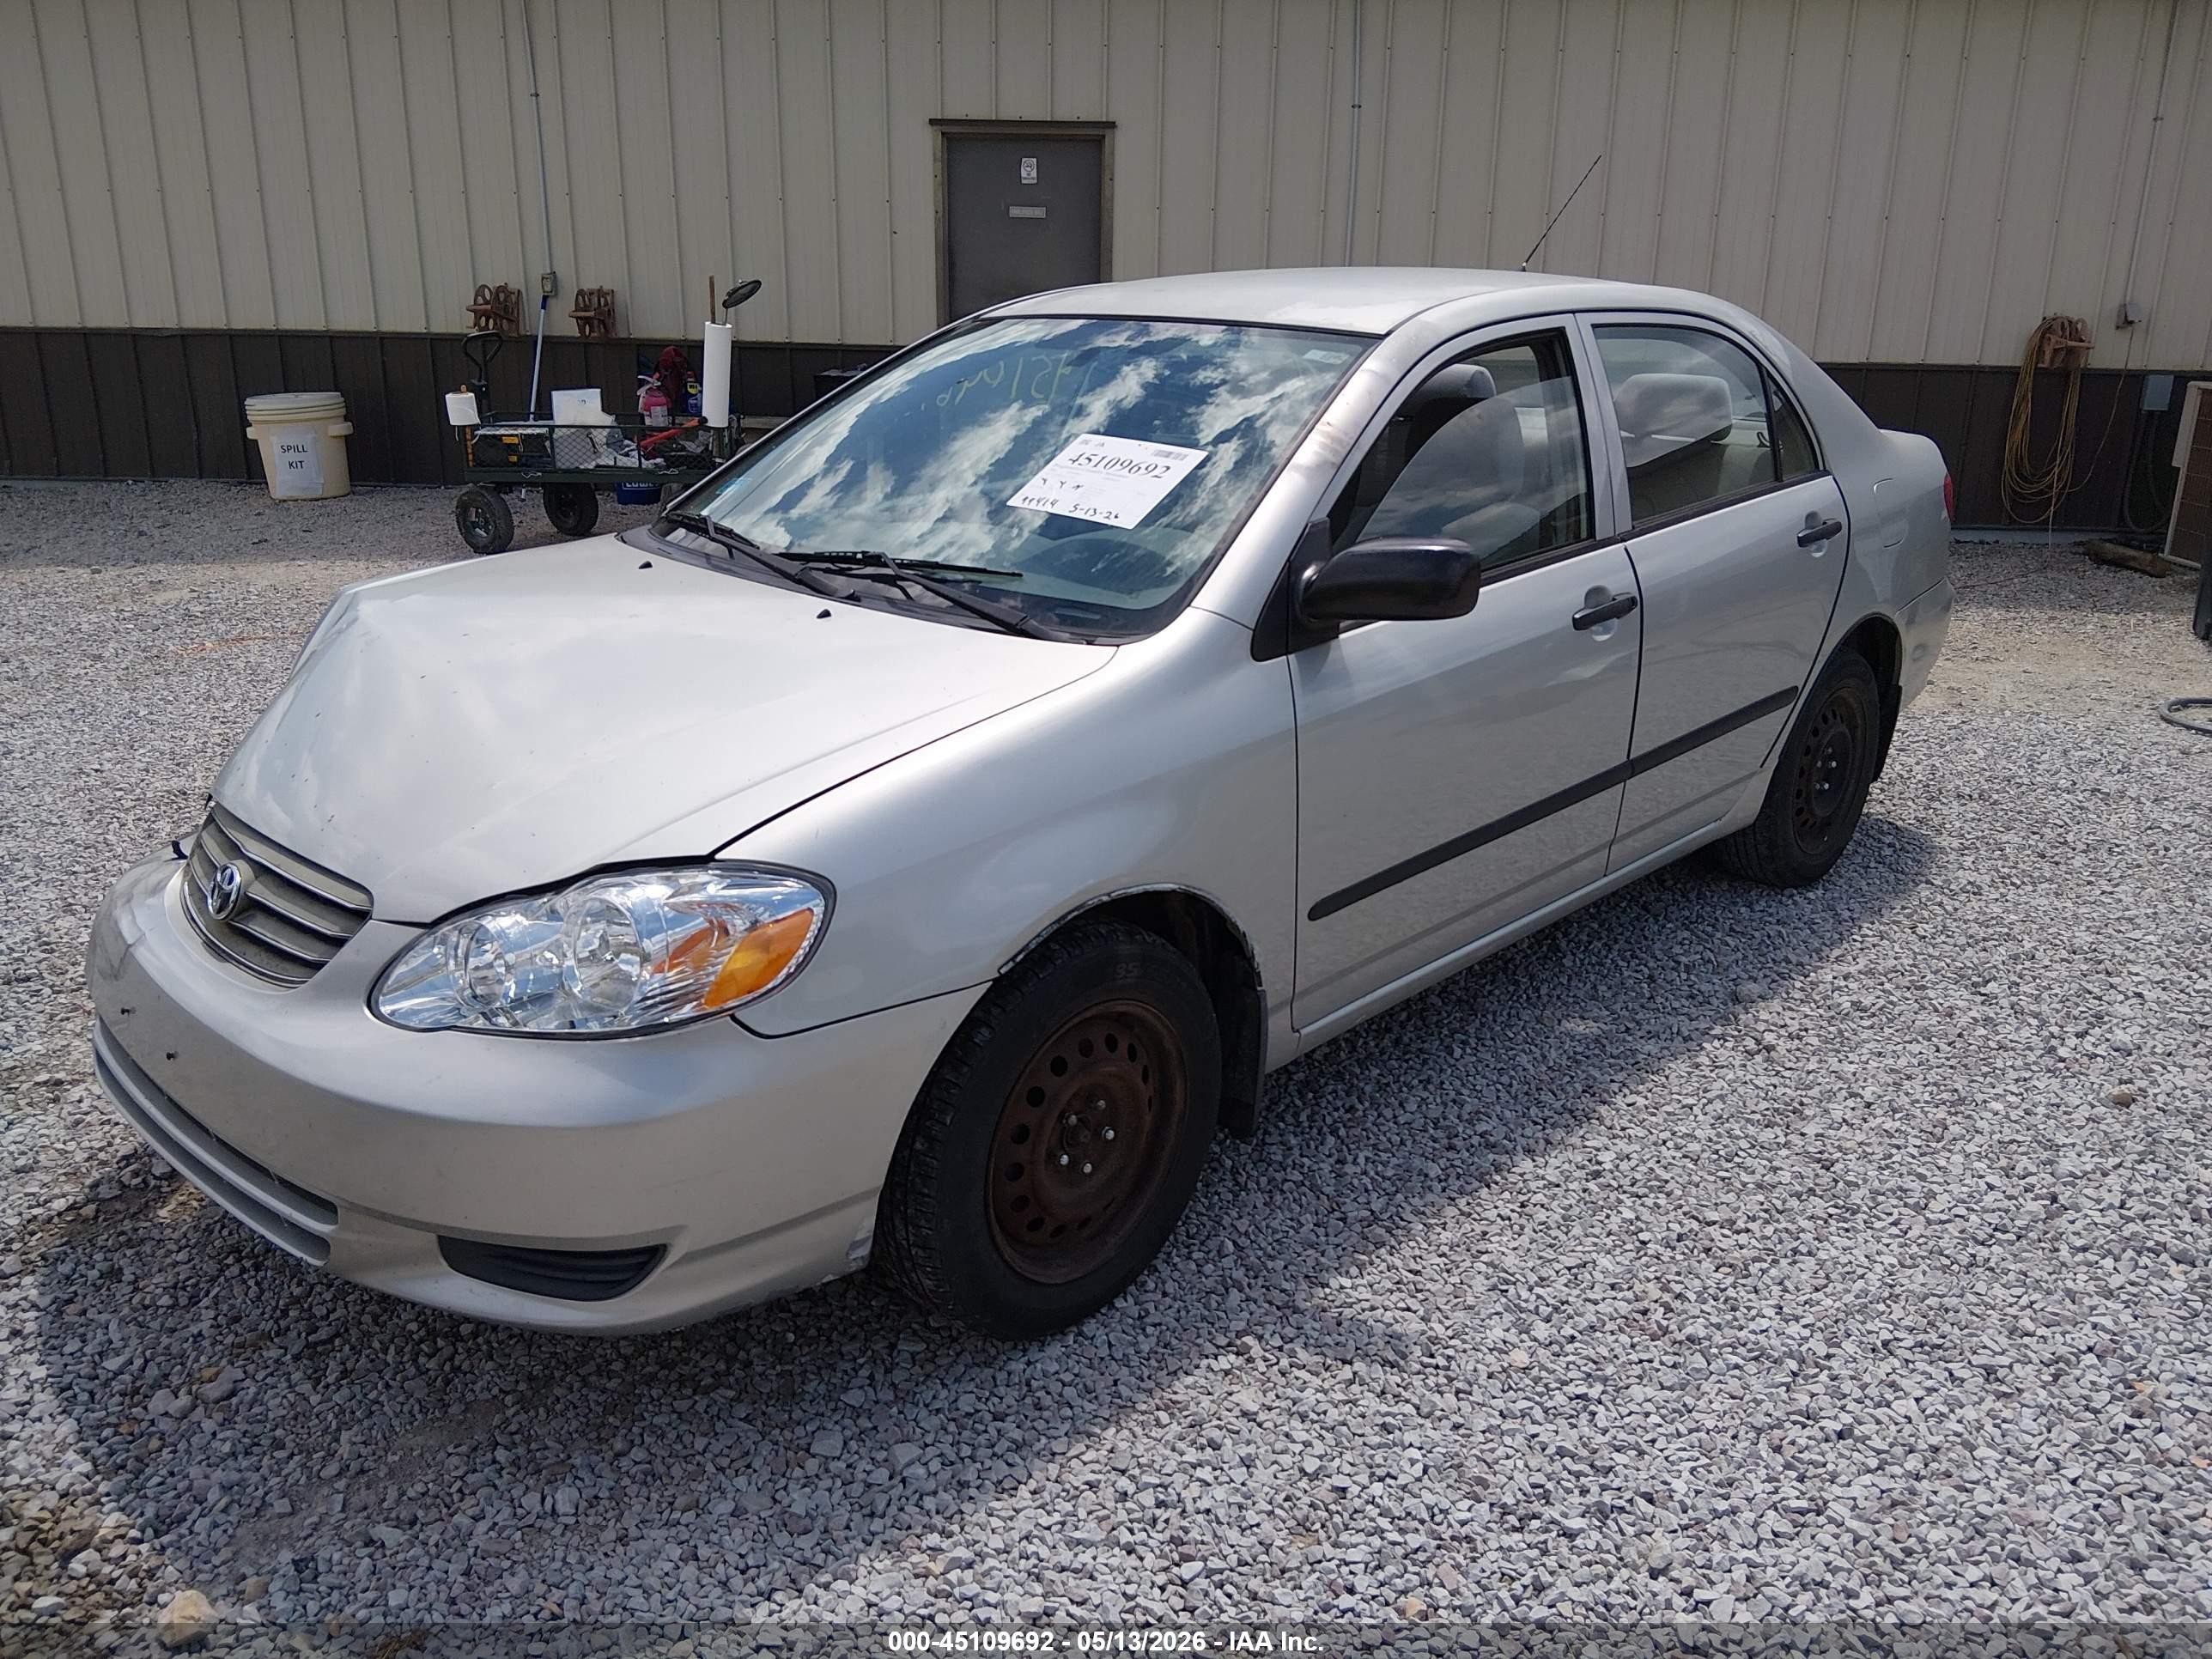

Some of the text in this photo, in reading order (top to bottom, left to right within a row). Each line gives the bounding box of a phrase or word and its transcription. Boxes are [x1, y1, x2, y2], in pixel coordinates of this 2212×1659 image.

[280, 445, 308, 453] SPILL
[288, 460, 305, 469] KIT
[1068, 453, 1171, 478] 45109692
